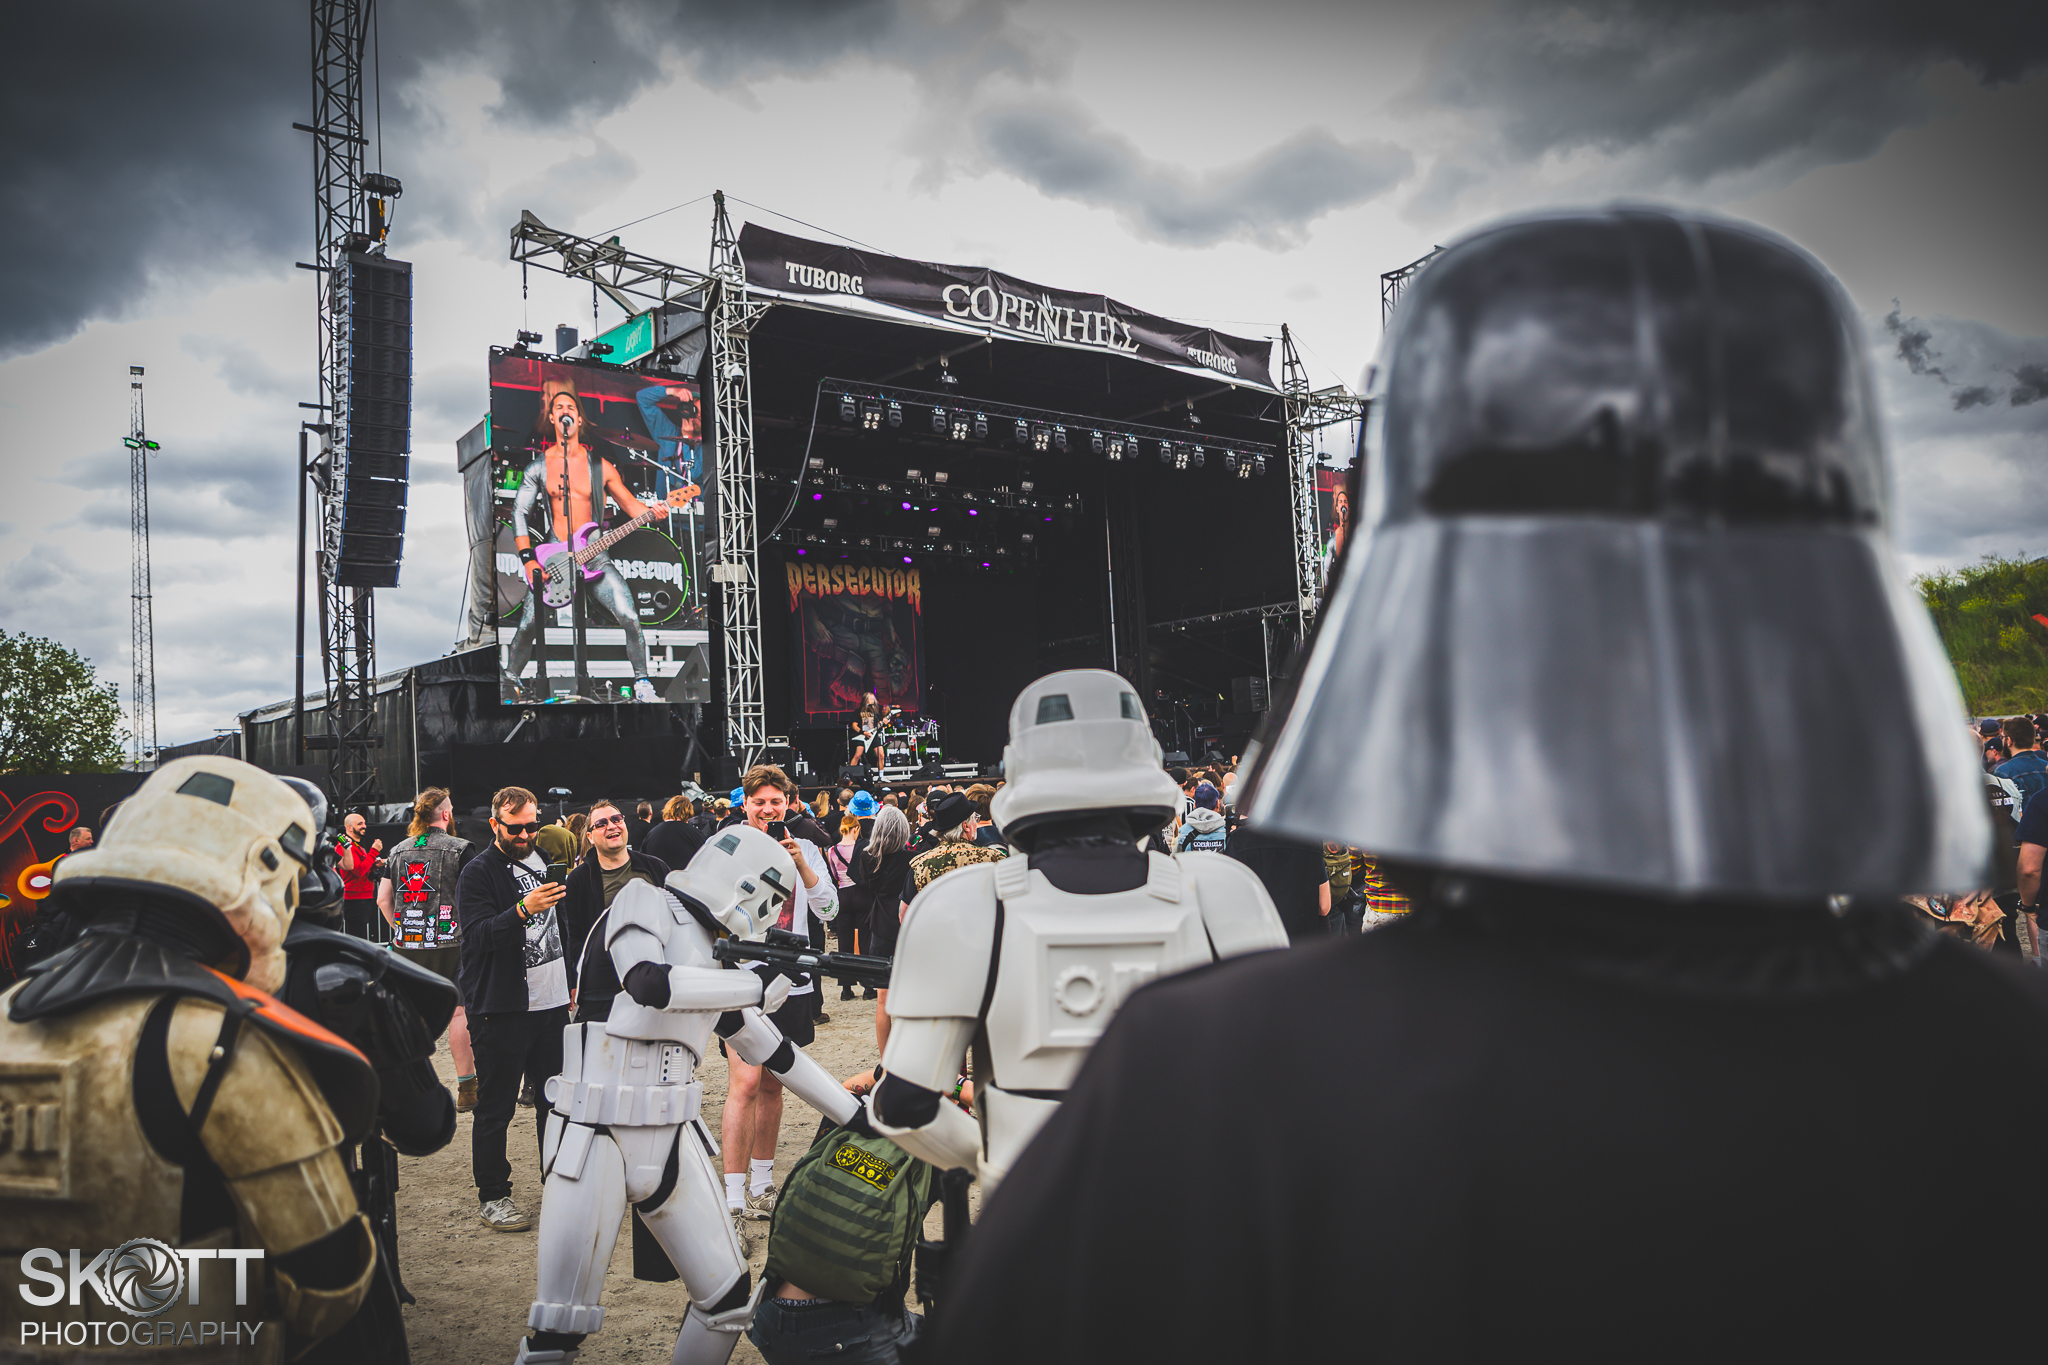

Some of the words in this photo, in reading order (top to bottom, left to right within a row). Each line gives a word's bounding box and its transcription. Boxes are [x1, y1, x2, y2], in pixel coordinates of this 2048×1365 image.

[785, 261, 863, 296] TUBORG
[942, 283, 1140, 356] COPENHELL
[611, 559, 684, 592] ERSECUTOR
[785, 561, 921, 617] PERSECUTOR
